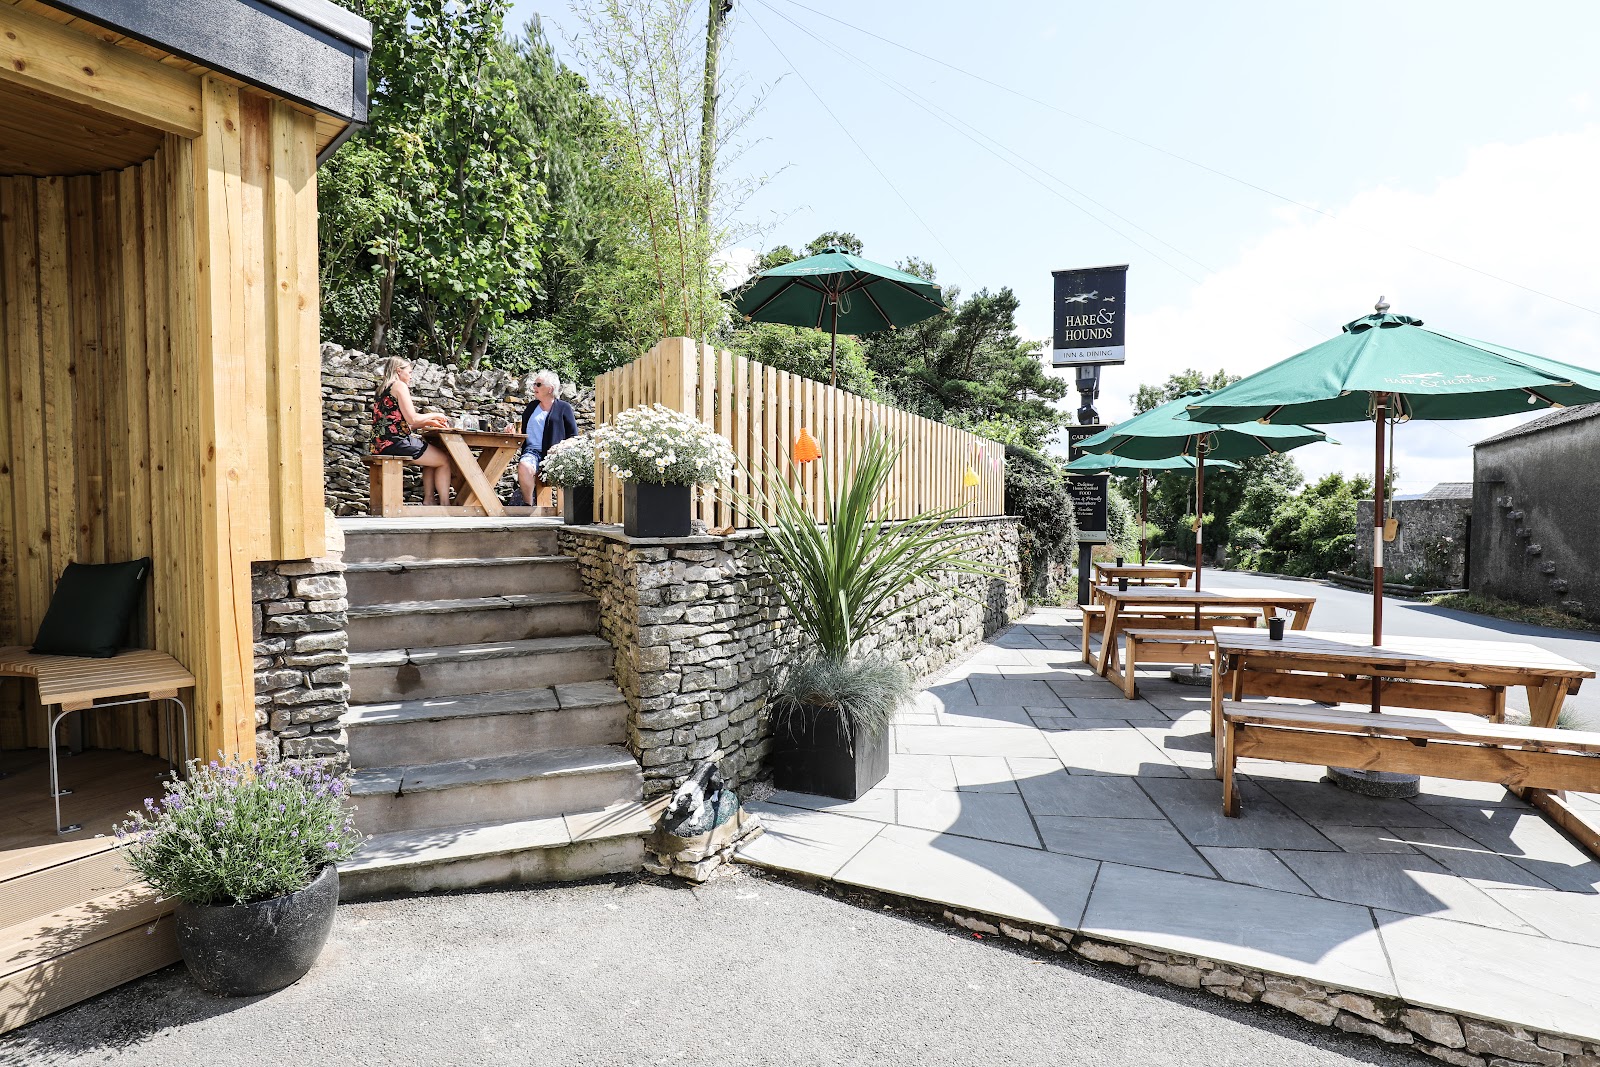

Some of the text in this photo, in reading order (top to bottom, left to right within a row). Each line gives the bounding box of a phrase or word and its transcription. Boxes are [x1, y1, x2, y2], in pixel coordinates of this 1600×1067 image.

[1065, 308, 1116, 327] HARE &
[1065, 327, 1113, 341] HOUNDS
[1441, 375, 1497, 386] HOUNDS
